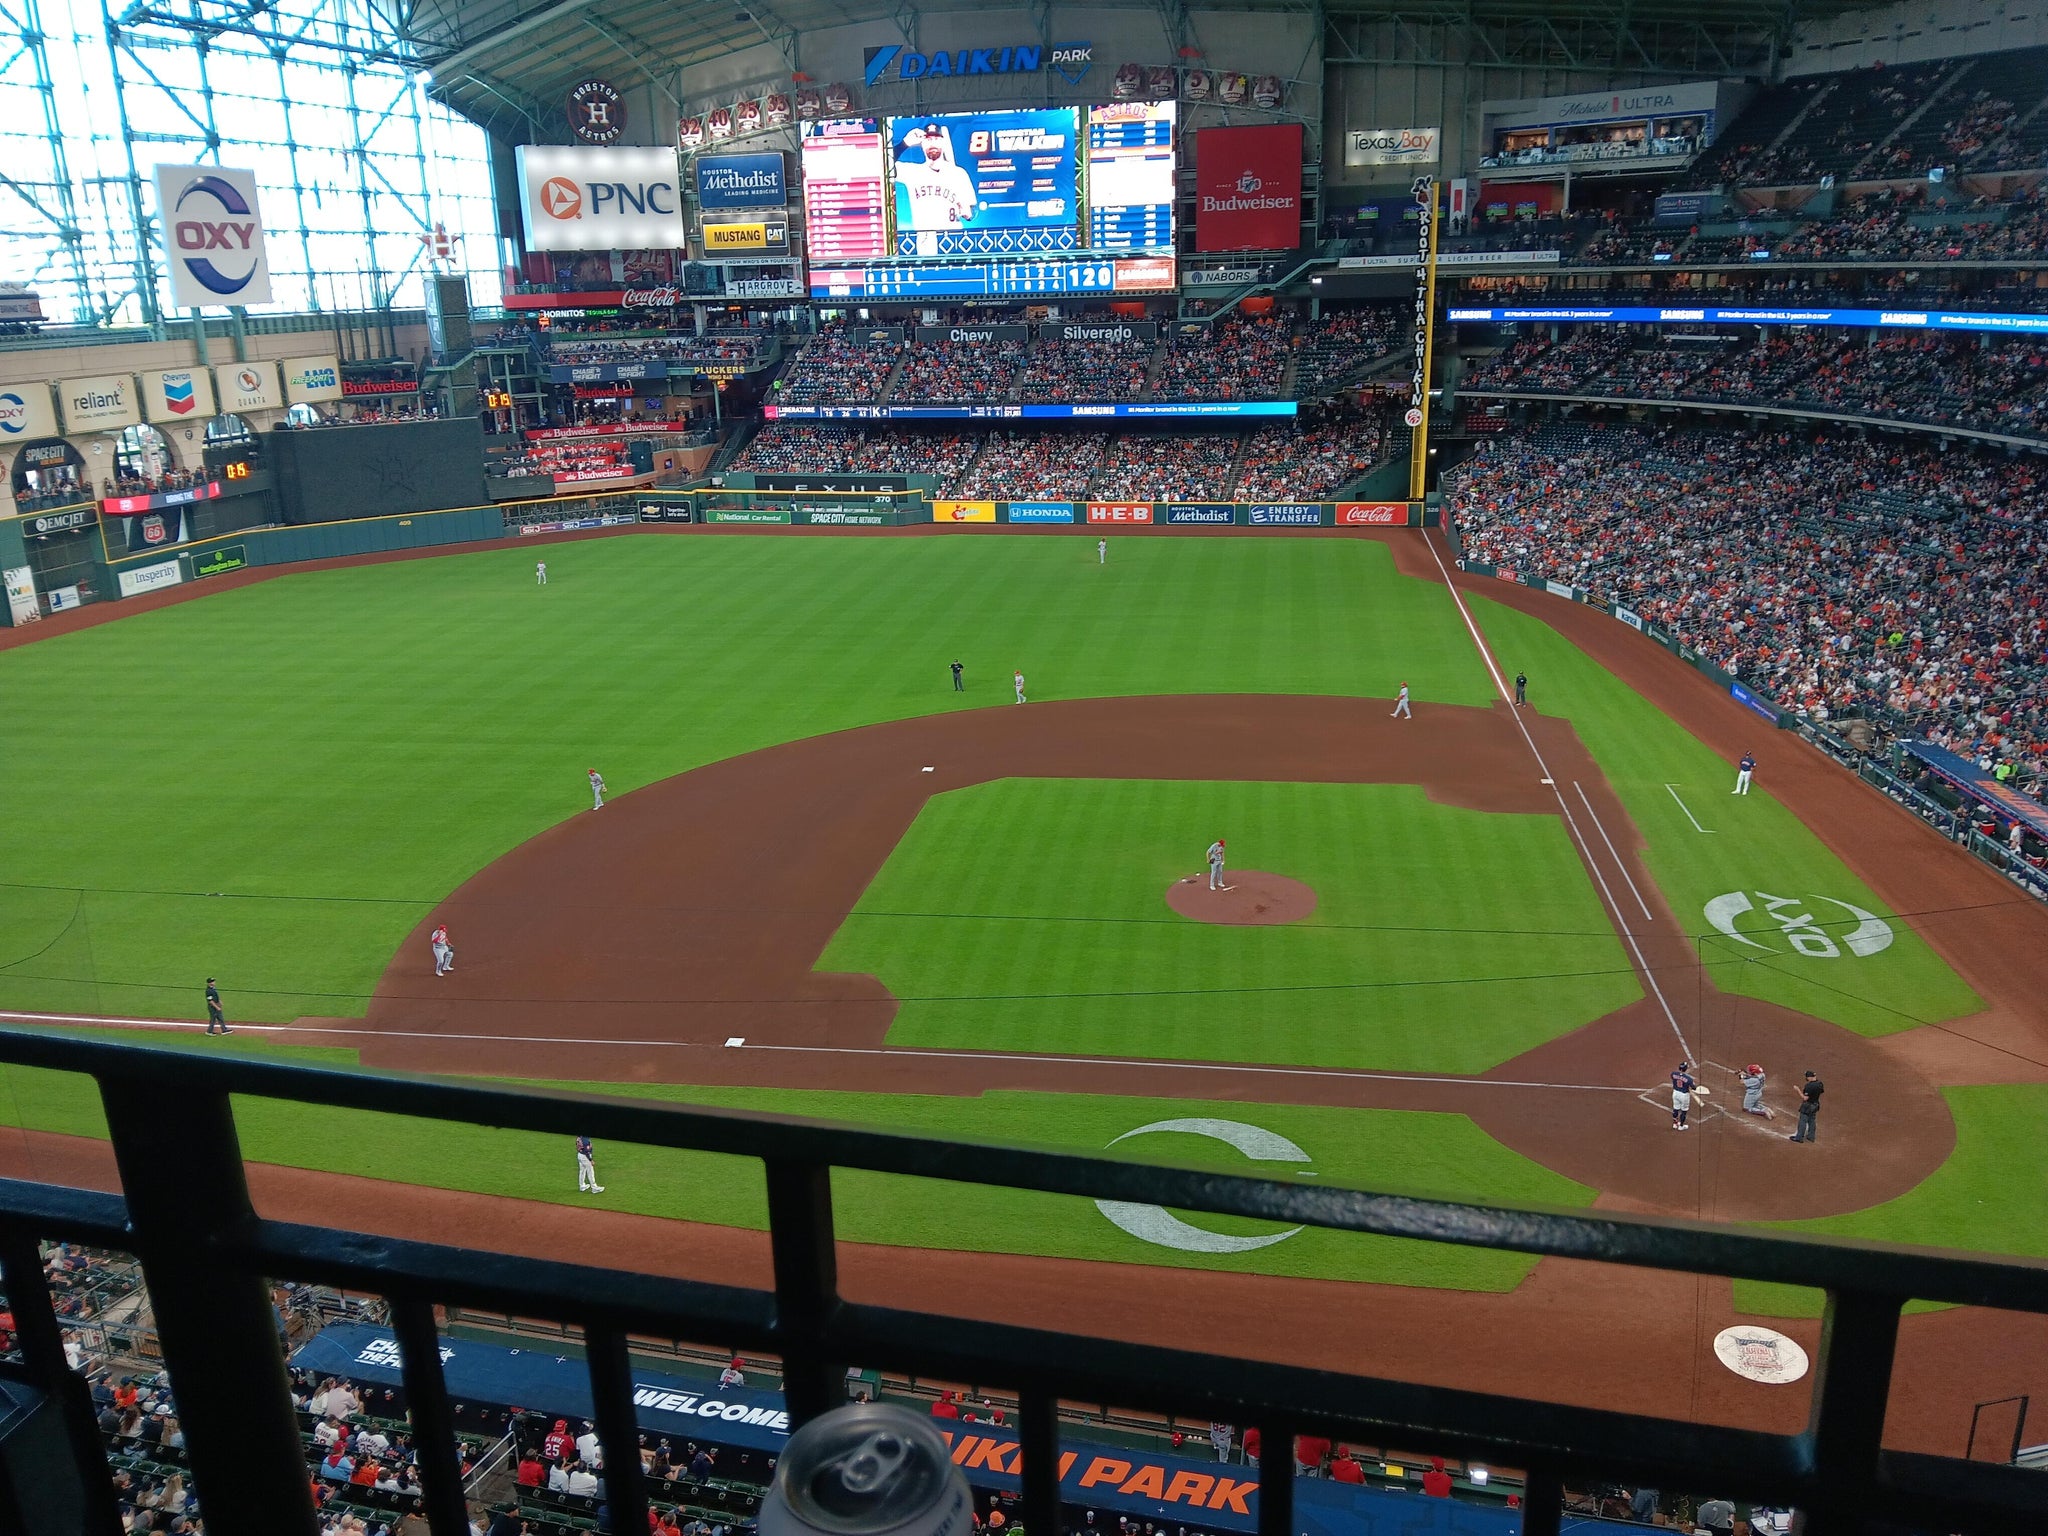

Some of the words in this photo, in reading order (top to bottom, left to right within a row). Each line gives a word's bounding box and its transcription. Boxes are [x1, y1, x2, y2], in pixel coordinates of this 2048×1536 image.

[900, 45, 1041, 78] DAIKIN
[1052, 47, 1092, 63] PARK
[1226, 72, 1239, 91] 7
[573, 83, 618, 100] HOUSTON
[737, 102, 758, 119] 25
[1624, 95, 1674, 110] ULTRA
[587, 102, 609, 123] H
[709, 109, 729, 127] 40
[1101, 103, 1149, 120] ASTROS
[579, 126, 619, 141] ASTROS
[680, 118, 701, 136] 32
[970, 131, 991, 154] 8
[1353, 133, 1396, 150] Texas
[1399, 130, 1434, 152] Bay
[1380, 154, 1402, 162] CREDIT
[1404, 152, 1430, 161] UNION
[702, 168, 733, 176] HOUSTON
[704, 171, 778, 190] Methodist
[1235, 175, 1262, 194] 150
[586, 182, 674, 214] PNC
[751, 188, 779, 196] MEDICINE
[914, 185, 956, 203] ASTROS
[1202, 194, 1294, 212] Budweiser
[949, 207, 956, 222] 8
[175, 220, 255, 250] OXY
[713, 229, 761, 243] MUSTANG
[766, 227, 784, 241] CAT
[1418, 211, 1431, 264] ROOT
[1206, 272, 1251, 282] NABORS
[1416, 267, 1427, 281] 4
[737, 281, 794, 294] HARGROVE
[544, 309, 585, 318] HORNITOS
[1414, 285, 1427, 326] THA
[950, 328, 993, 344] Chevy
[1063, 325, 1132, 341] Silverado
[694, 365, 745, 374] PLUCKERS
[1411, 330, 1426, 406] CHIKIN
[162, 373, 191, 382] Chevron
[290, 374, 330, 385] FREEPORT
[343, 379, 418, 395] Budweiser
[73, 390, 122, 410] reliant
[487, 393, 511, 408] 0:19
[872, 407, 880, 417] K
[553, 427, 600, 438] Budweiser
[625, 423, 669, 432] Budweiser
[26, 446, 49, 462] SPACE
[49, 445, 65, 458] CITY
[577, 468, 624, 480] Budweiser
[724, 513, 750, 521] National
[811, 514, 831, 523] SPACE
[831, 513, 846, 523] CITY
[845, 516, 858, 524] HOME
[859, 516, 882, 524] NETWORK
[1022, 508, 1072, 517] HONDA
[1092, 508, 1148, 520] H-E-B
[1171, 510, 1230, 522] Methodist
[1268, 514, 1319, 523] TRANSFER
[1269, 506, 1309, 515] ENERGY
[1347, 506, 1393, 522] Coca-Cola
[47, 512, 84, 529] EMCJET
[147, 527, 160, 538] 66
[135, 564, 176, 584] Insperity
[1755, 890, 1841, 958] OXY
[358, 1350, 386, 1363] THE
[633, 1388, 791, 1430] WELCOME
[360, 1443, 373, 1454] 35
[545, 1443, 560, 1457] 25
[1079, 1454, 1261, 1516] PARK
